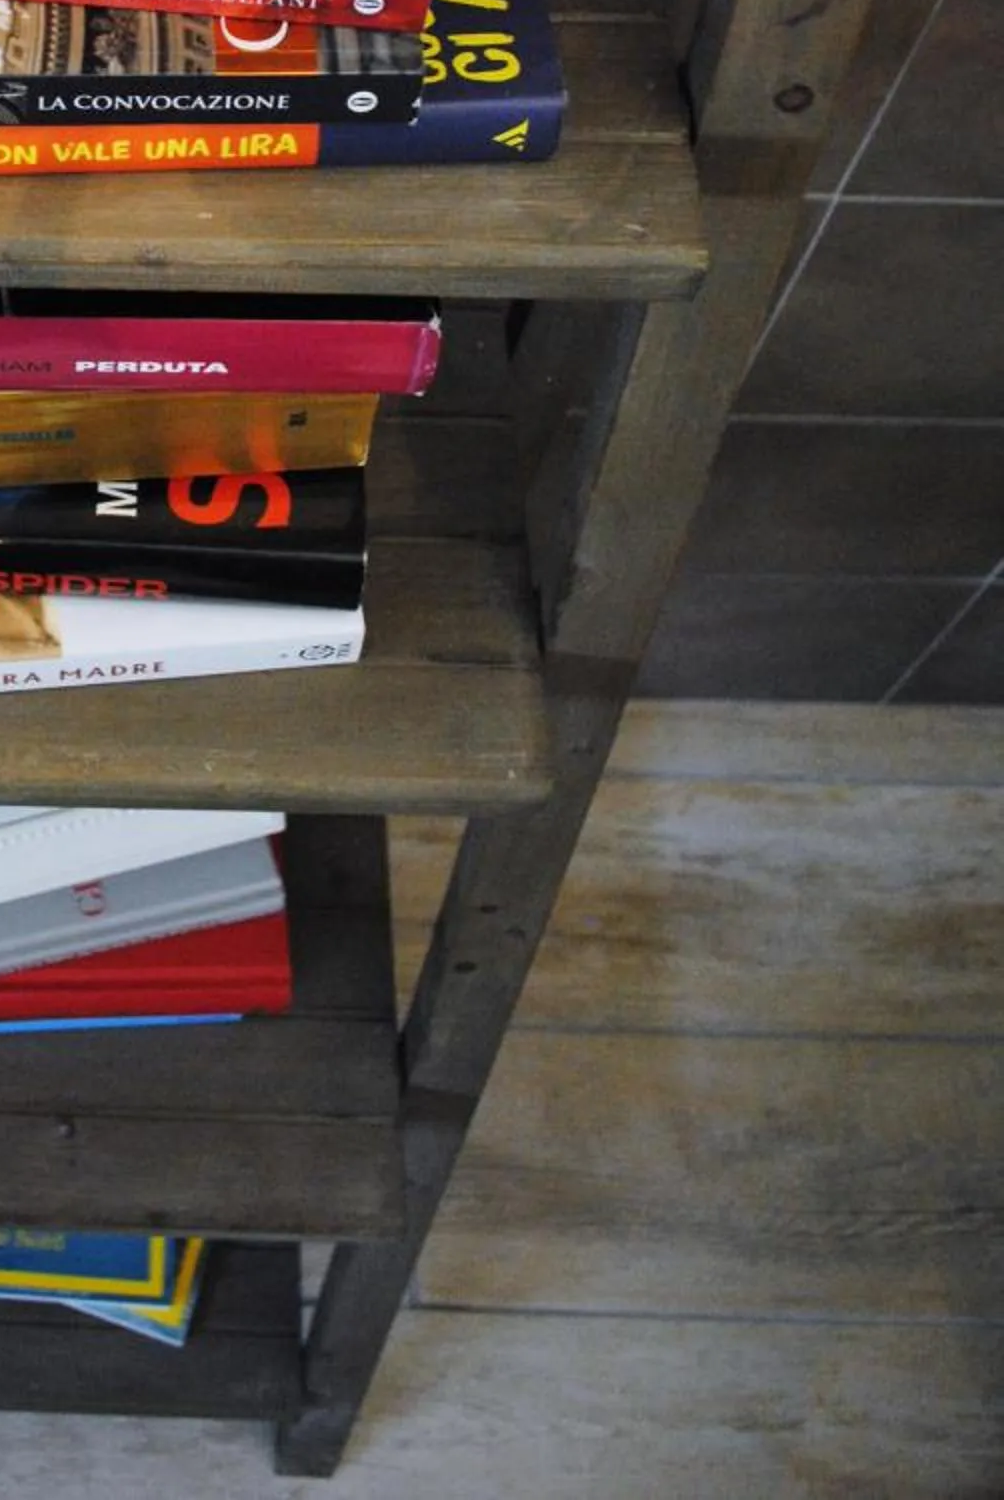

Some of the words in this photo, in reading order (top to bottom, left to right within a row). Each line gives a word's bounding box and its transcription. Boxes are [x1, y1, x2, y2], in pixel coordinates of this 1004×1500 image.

[448, 32, 522, 84] CI
[37, 95, 67, 111] LA
[72, 93, 291, 111] CONVOCAZIONE
[51, 139, 131, 163] VALE
[145, 137, 210, 160] UNA
[219, 132, 298, 159] LIRA
[74, 360, 229, 374] PERDUTA
[59, 660, 168, 682] MADRE
